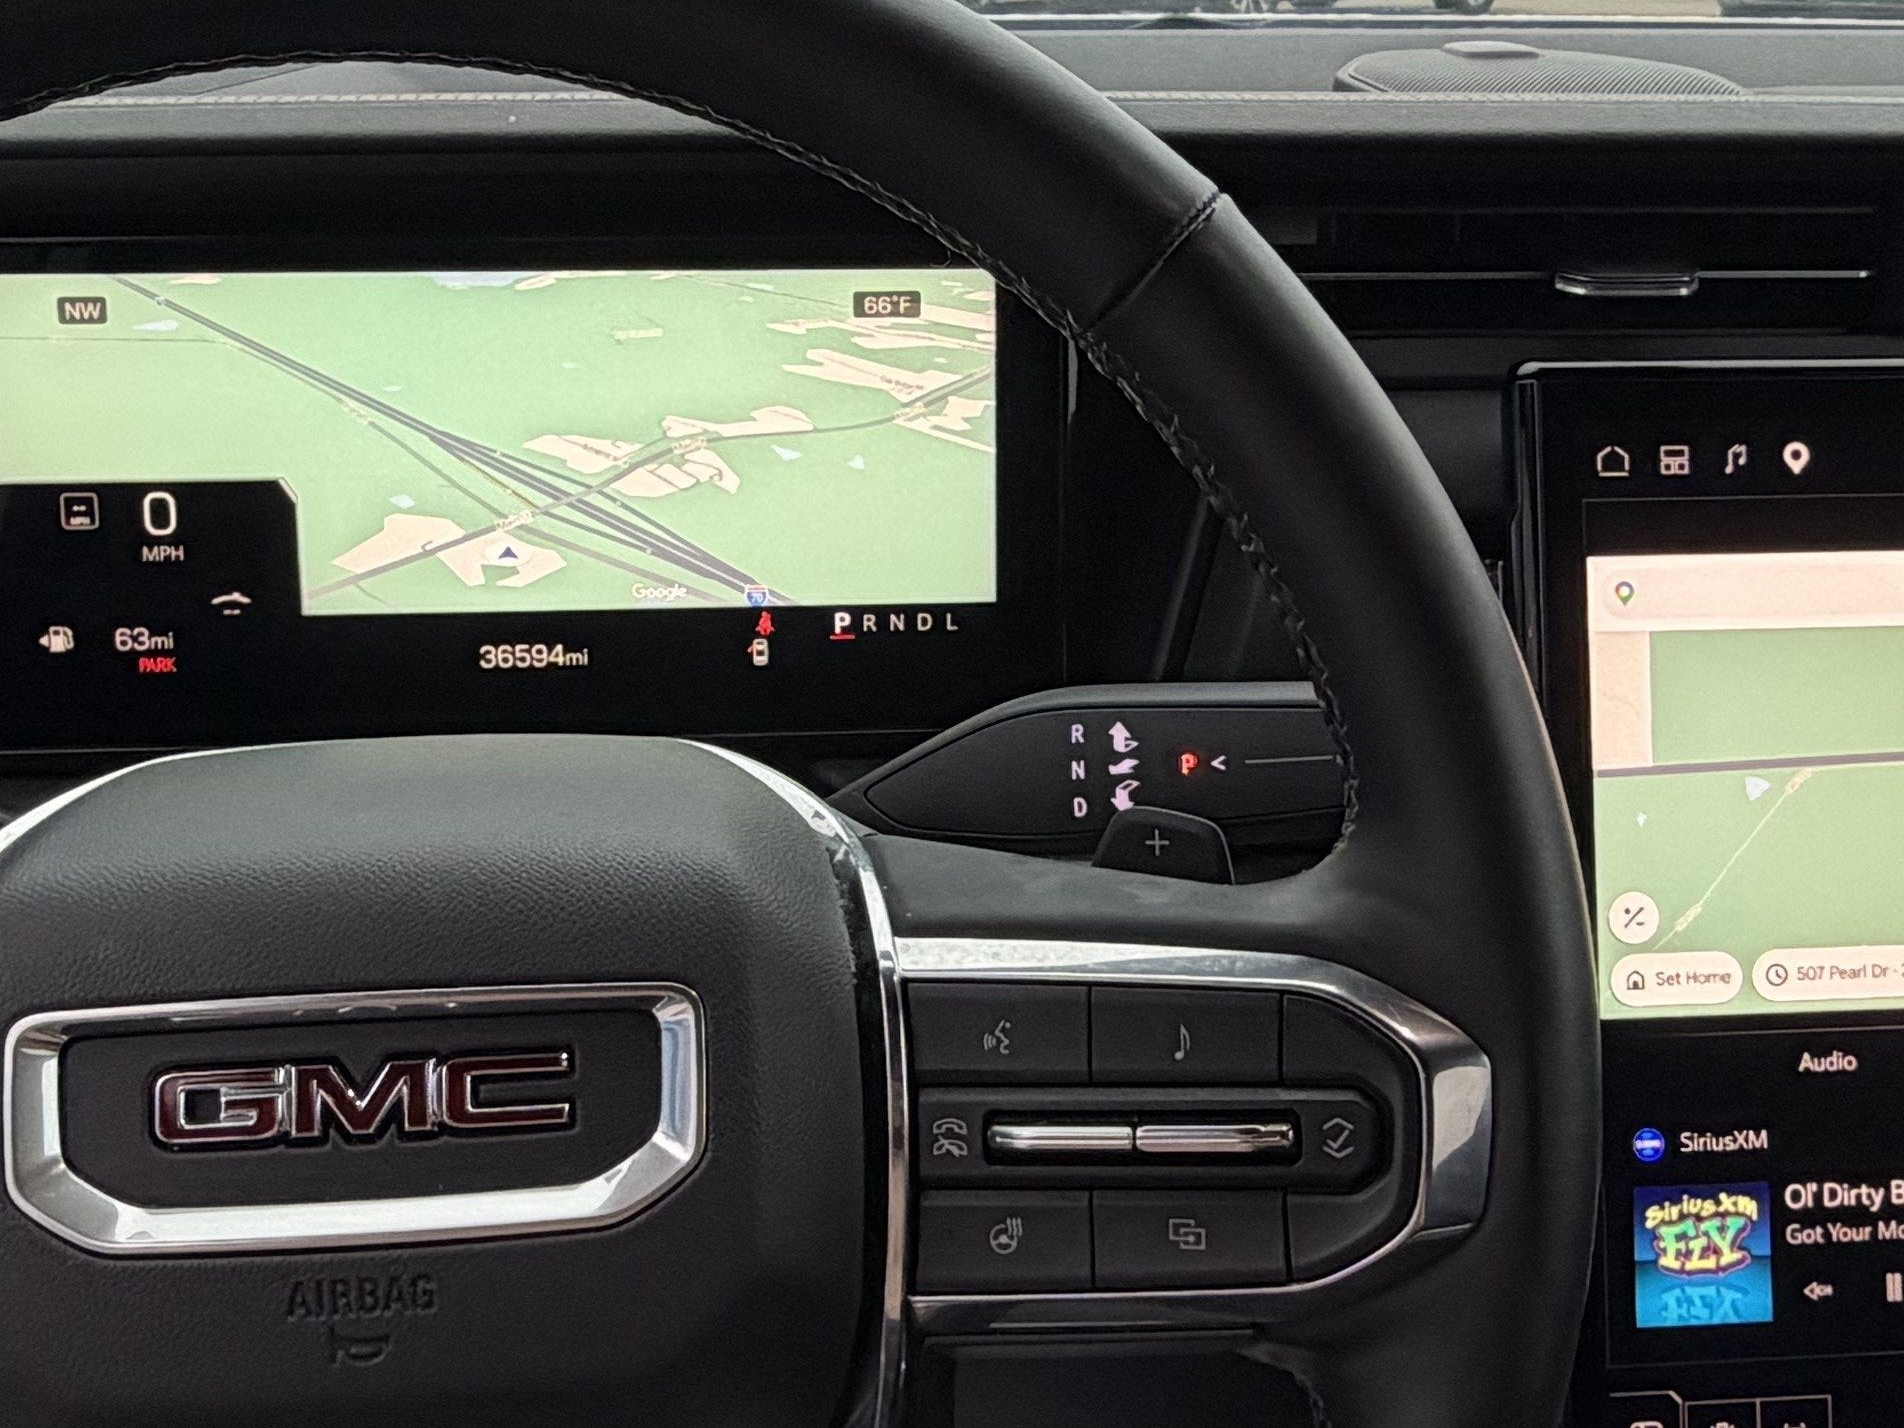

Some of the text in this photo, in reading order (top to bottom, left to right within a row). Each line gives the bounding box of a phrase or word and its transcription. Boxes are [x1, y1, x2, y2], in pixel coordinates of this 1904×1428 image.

[64, 301, 102, 321] NW
[862, 295, 912, 316] 66°F
[142, 491, 177, 536] 0
[141, 545, 185, 562] MPH
[631, 582, 688, 602] Google
[834, 611, 959, 635] P R N D L
[1070, 723, 1085, 744] R
[1070, 760, 1086, 781] N
[1179, 753, 1199, 776] P
[1072, 797, 1088, 818] D
[1655, 969, 1732, 988] Set Home
[1795, 963, 1826, 981] 507
[1829, 963, 1867, 980] Pearl
[1871, 963, 1890, 979] Dr
[1797, 1051, 1858, 1074] Audio
[150, 1047, 573, 1151] GMC
[1679, 1129, 1769, 1153] SiriusXM
[1822, 1182, 1886, 1212] Dirty
[1785, 1223, 1826, 1246] Got
[1827, 1221, 1872, 1243] Your
[286, 1273, 437, 1323] AIRBAG
